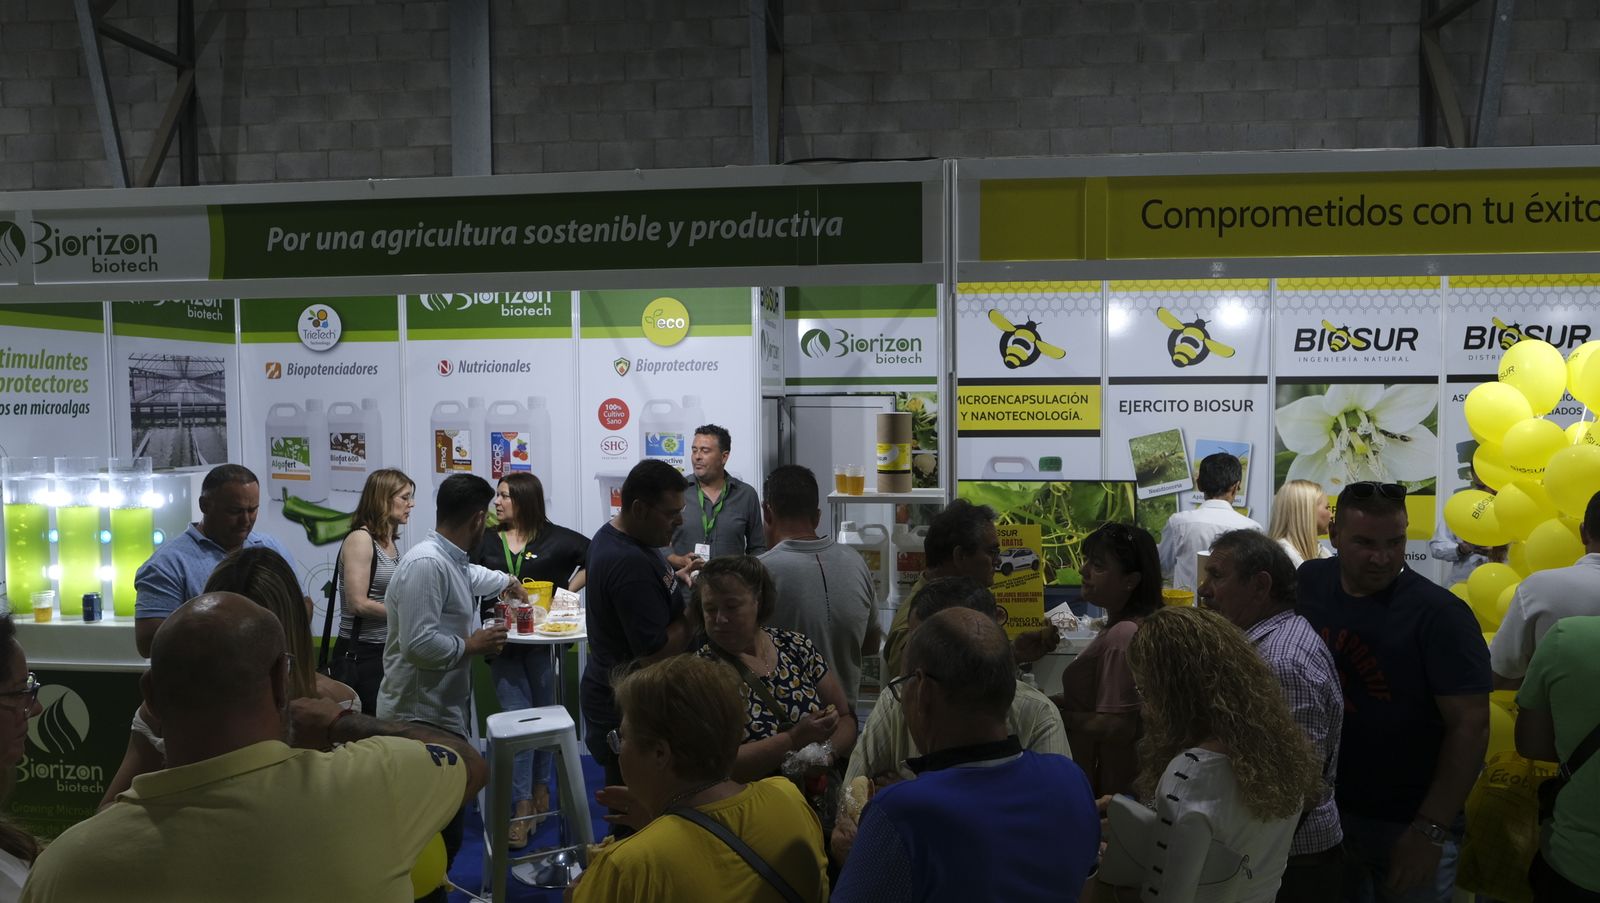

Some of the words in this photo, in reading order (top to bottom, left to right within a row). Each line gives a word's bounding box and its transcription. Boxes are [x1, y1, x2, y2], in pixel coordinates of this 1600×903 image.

[1141, 195, 1402, 237] Comprometidos
[1413, 201, 1471, 225] con
[1483, 196, 1514, 223] tu
[267, 226, 310, 252] Por
[316, 230, 364, 250] una
[371, 219, 517, 255] agricultura
[523, 214, 662, 244] sostenible
[666, 221, 684, 248] y
[689, 210, 844, 247] productiva
[31, 220, 157, 265] Biorizon
[92, 257, 158, 273] biotech
[187, 308, 223, 321] biotech
[501, 303, 552, 316] biotech
[656, 318, 685, 329] eco
[834, 328, 922, 358] Biorizon
[1294, 327, 1419, 352] BIOSUR
[458, 359, 531, 373] Nutricionales
[636, 358, 719, 375] Bioprotectores
[876, 353, 922, 364] biotech
[287, 361, 378, 378] Biopotenciadores
[13, 402, 28, 416] en
[30, 399, 91, 418] microalgas
[960, 411, 968, 421] Y
[971, 408, 1083, 421] NANOTECNOLOGÍA.
[1119, 399, 1189, 415] EJERCITO
[1194, 399, 1254, 412] BIOSUR
[604, 440, 626, 451] SHC
[16, 752, 104, 783] Biorizon
[56, 780, 105, 793] biotech
